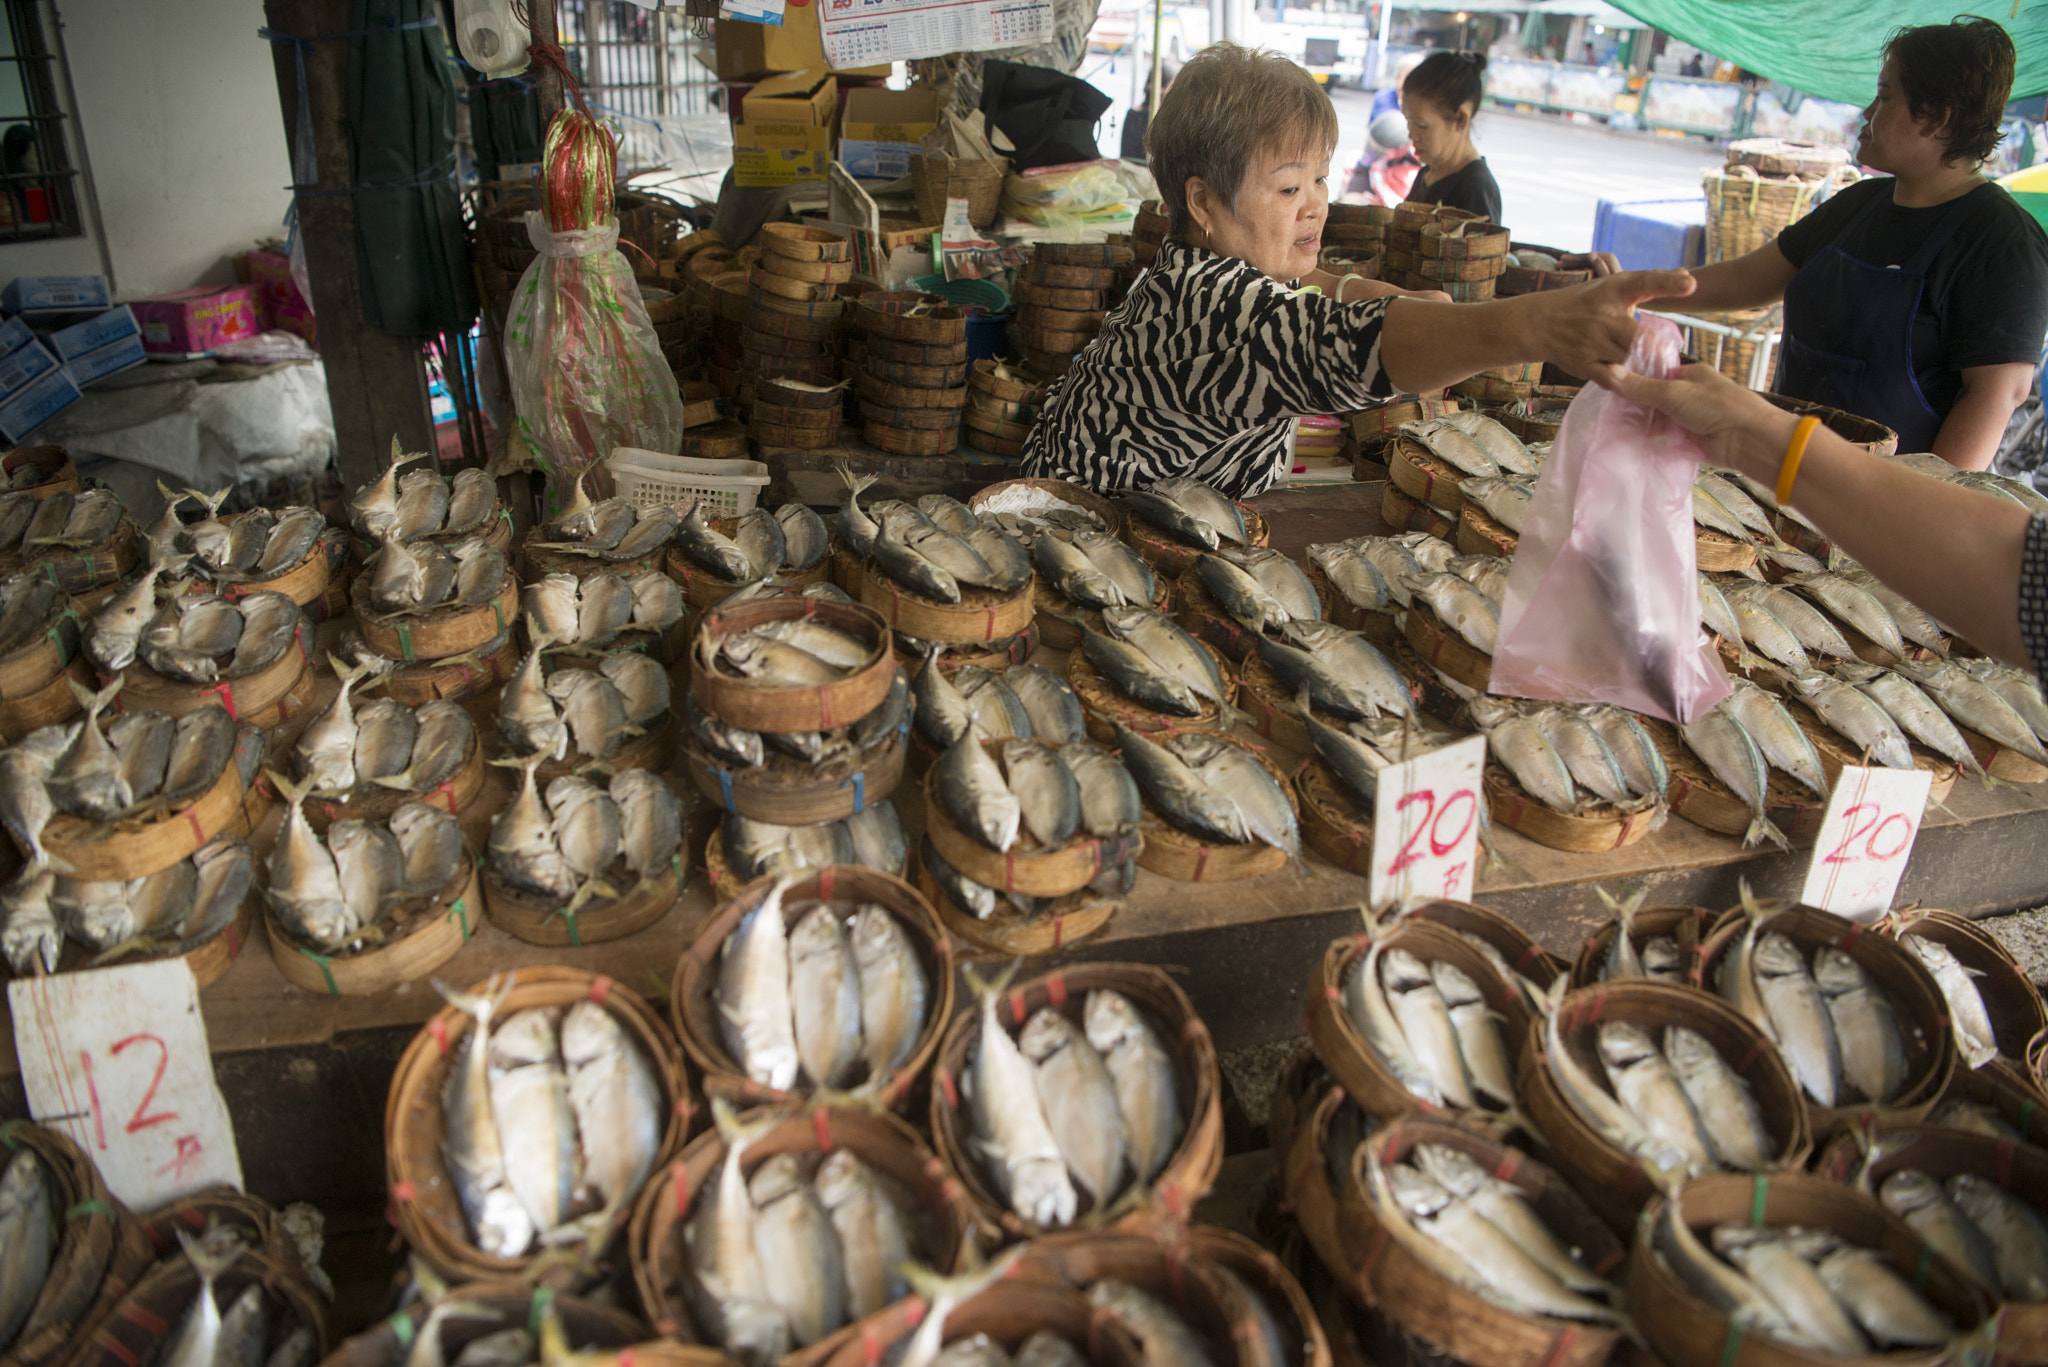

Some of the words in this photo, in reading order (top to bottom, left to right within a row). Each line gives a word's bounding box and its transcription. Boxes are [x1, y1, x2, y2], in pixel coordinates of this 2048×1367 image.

[1387, 789, 1477, 876] 20
[1822, 802, 1912, 865] 20
[81, 1033, 180, 1151] 12
